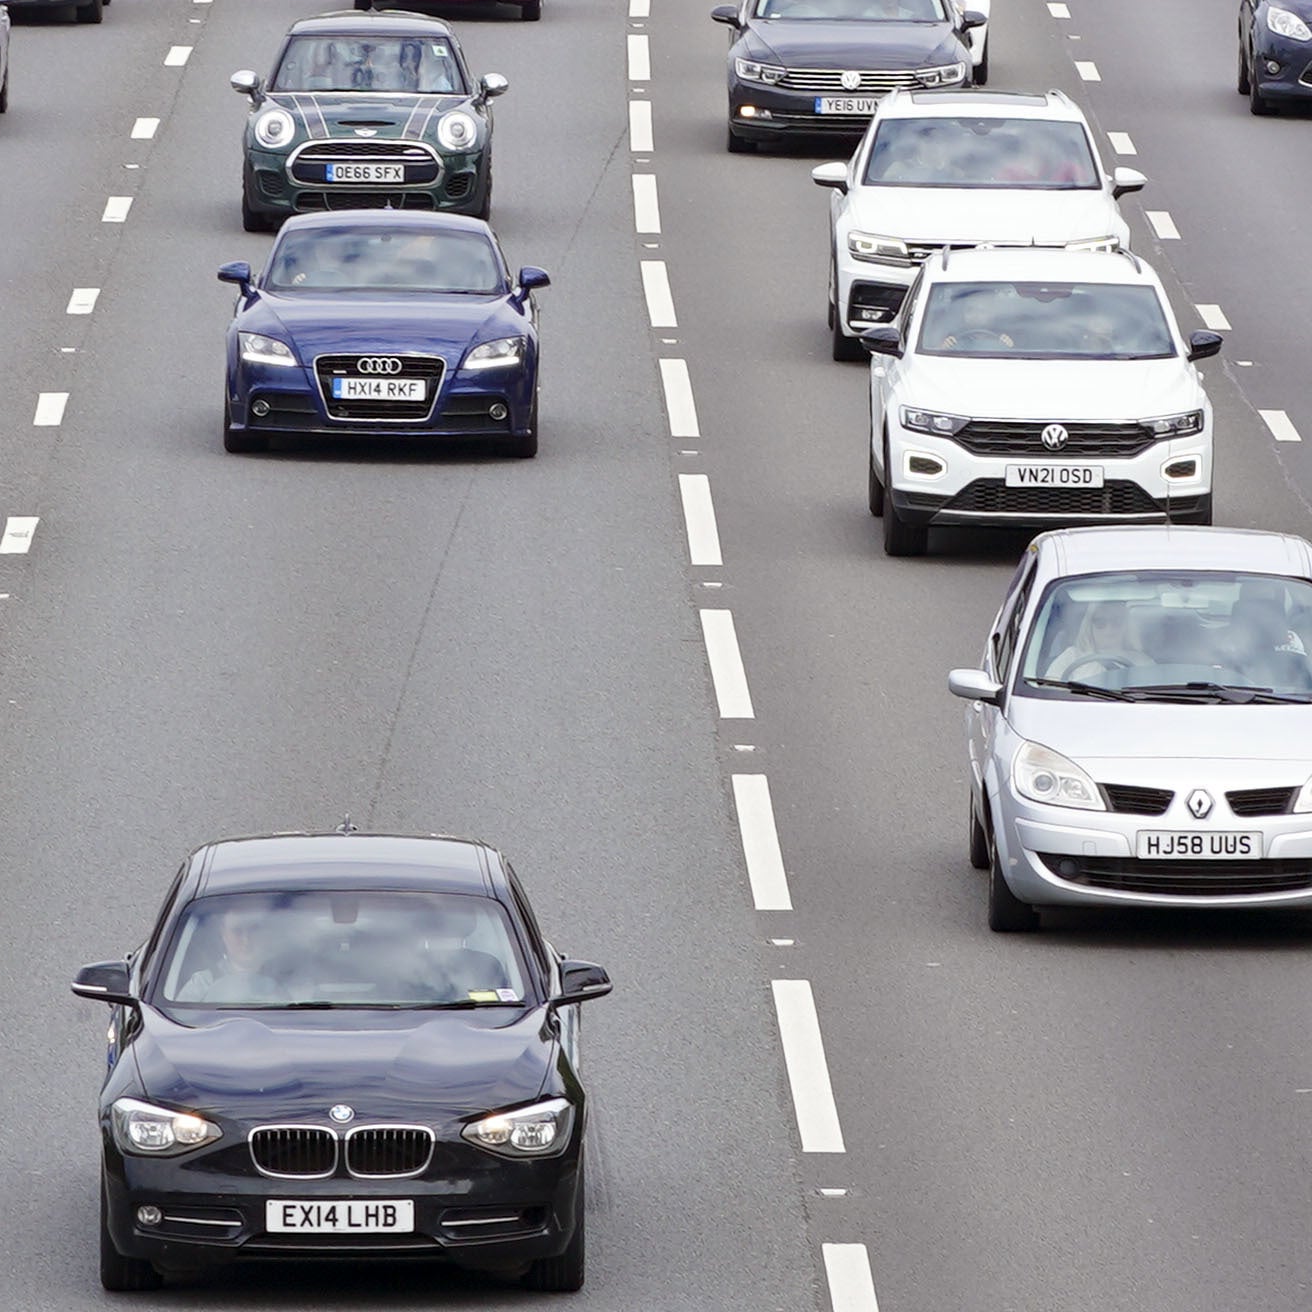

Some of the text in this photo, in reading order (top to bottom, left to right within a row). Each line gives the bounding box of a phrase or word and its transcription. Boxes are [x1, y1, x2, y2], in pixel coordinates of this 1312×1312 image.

[827, 100, 853, 111] YE16
[336, 167, 402, 180] OE66 SFX
[348, 382, 417, 396] HX14 RKF
[1018, 468, 1092, 483] VN21 OSD
[1148, 836, 1250, 854] HJ58 UUS
[283, 1205, 396, 1227] EX14 LHB
